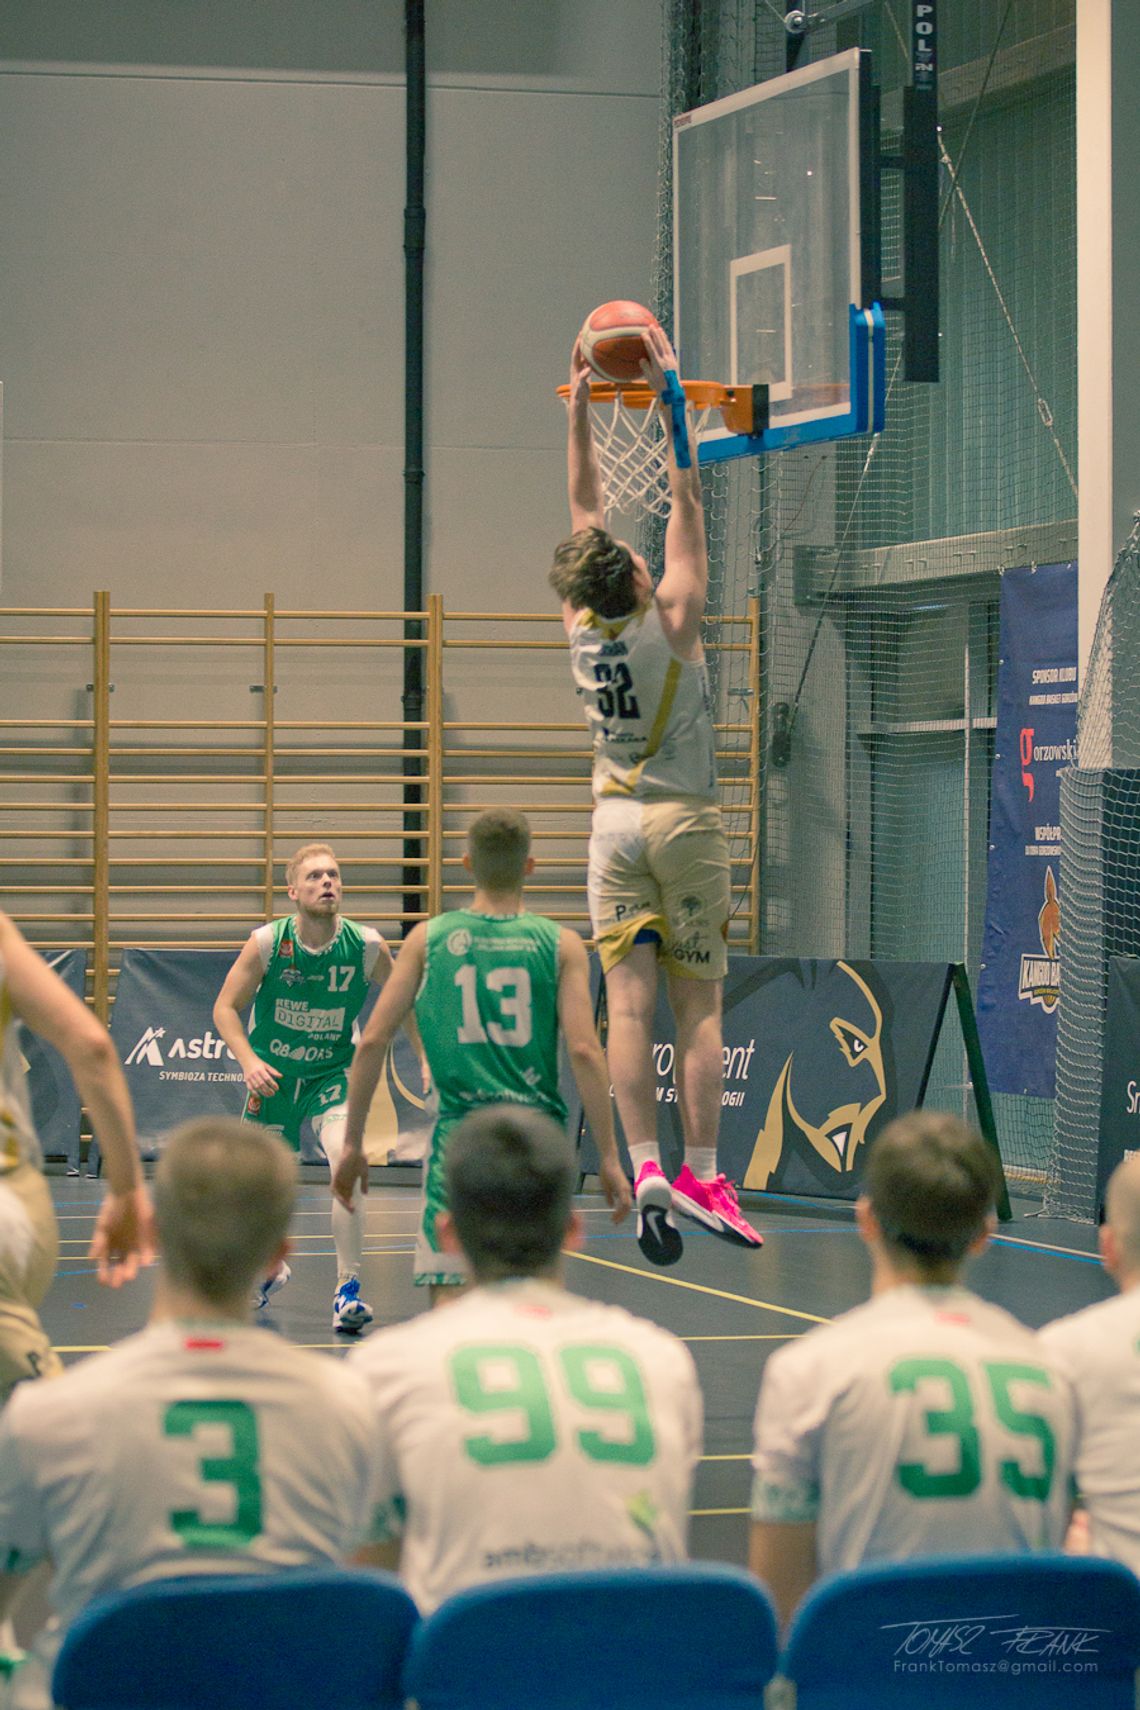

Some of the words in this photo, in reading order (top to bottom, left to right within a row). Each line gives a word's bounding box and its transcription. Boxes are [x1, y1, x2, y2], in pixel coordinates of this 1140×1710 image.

[275, 998, 309, 1012] REWE
[327, 965, 356, 992] 17
[454, 964, 532, 1048] 13
[278, 1010, 340, 1029] DIGITAL
[159, 1070, 205, 1081] SYMBIOZA
[451, 1344, 657, 1467] 99
[889, 1359, 1056, 1503] 35
[163, 1399, 263, 1549] 3
